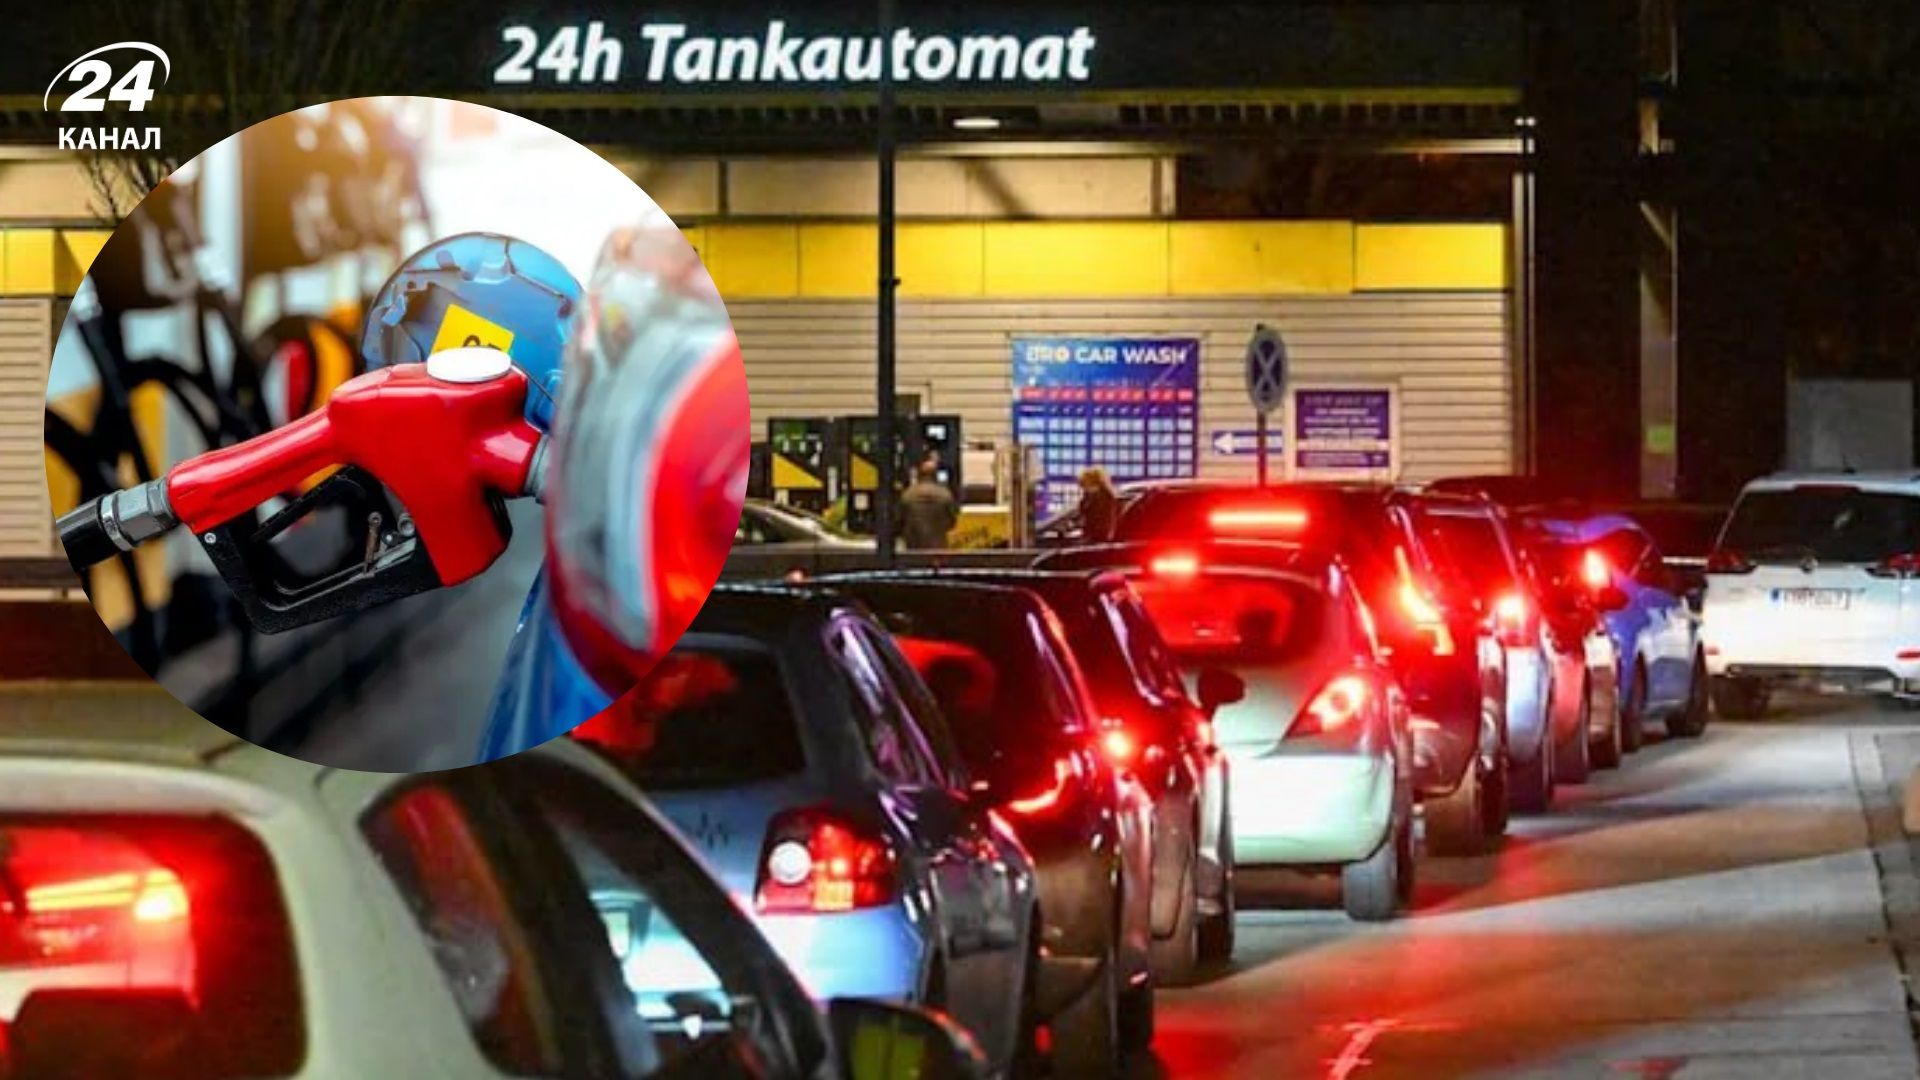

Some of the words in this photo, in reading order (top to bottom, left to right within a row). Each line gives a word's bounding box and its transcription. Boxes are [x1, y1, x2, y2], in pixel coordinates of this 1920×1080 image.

[494, 21, 621, 82] 24h
[642, 20, 1095, 82] Tankautomat
[1074, 346, 1118, 363] CAR
[1121, 346, 1188, 364] WASH
